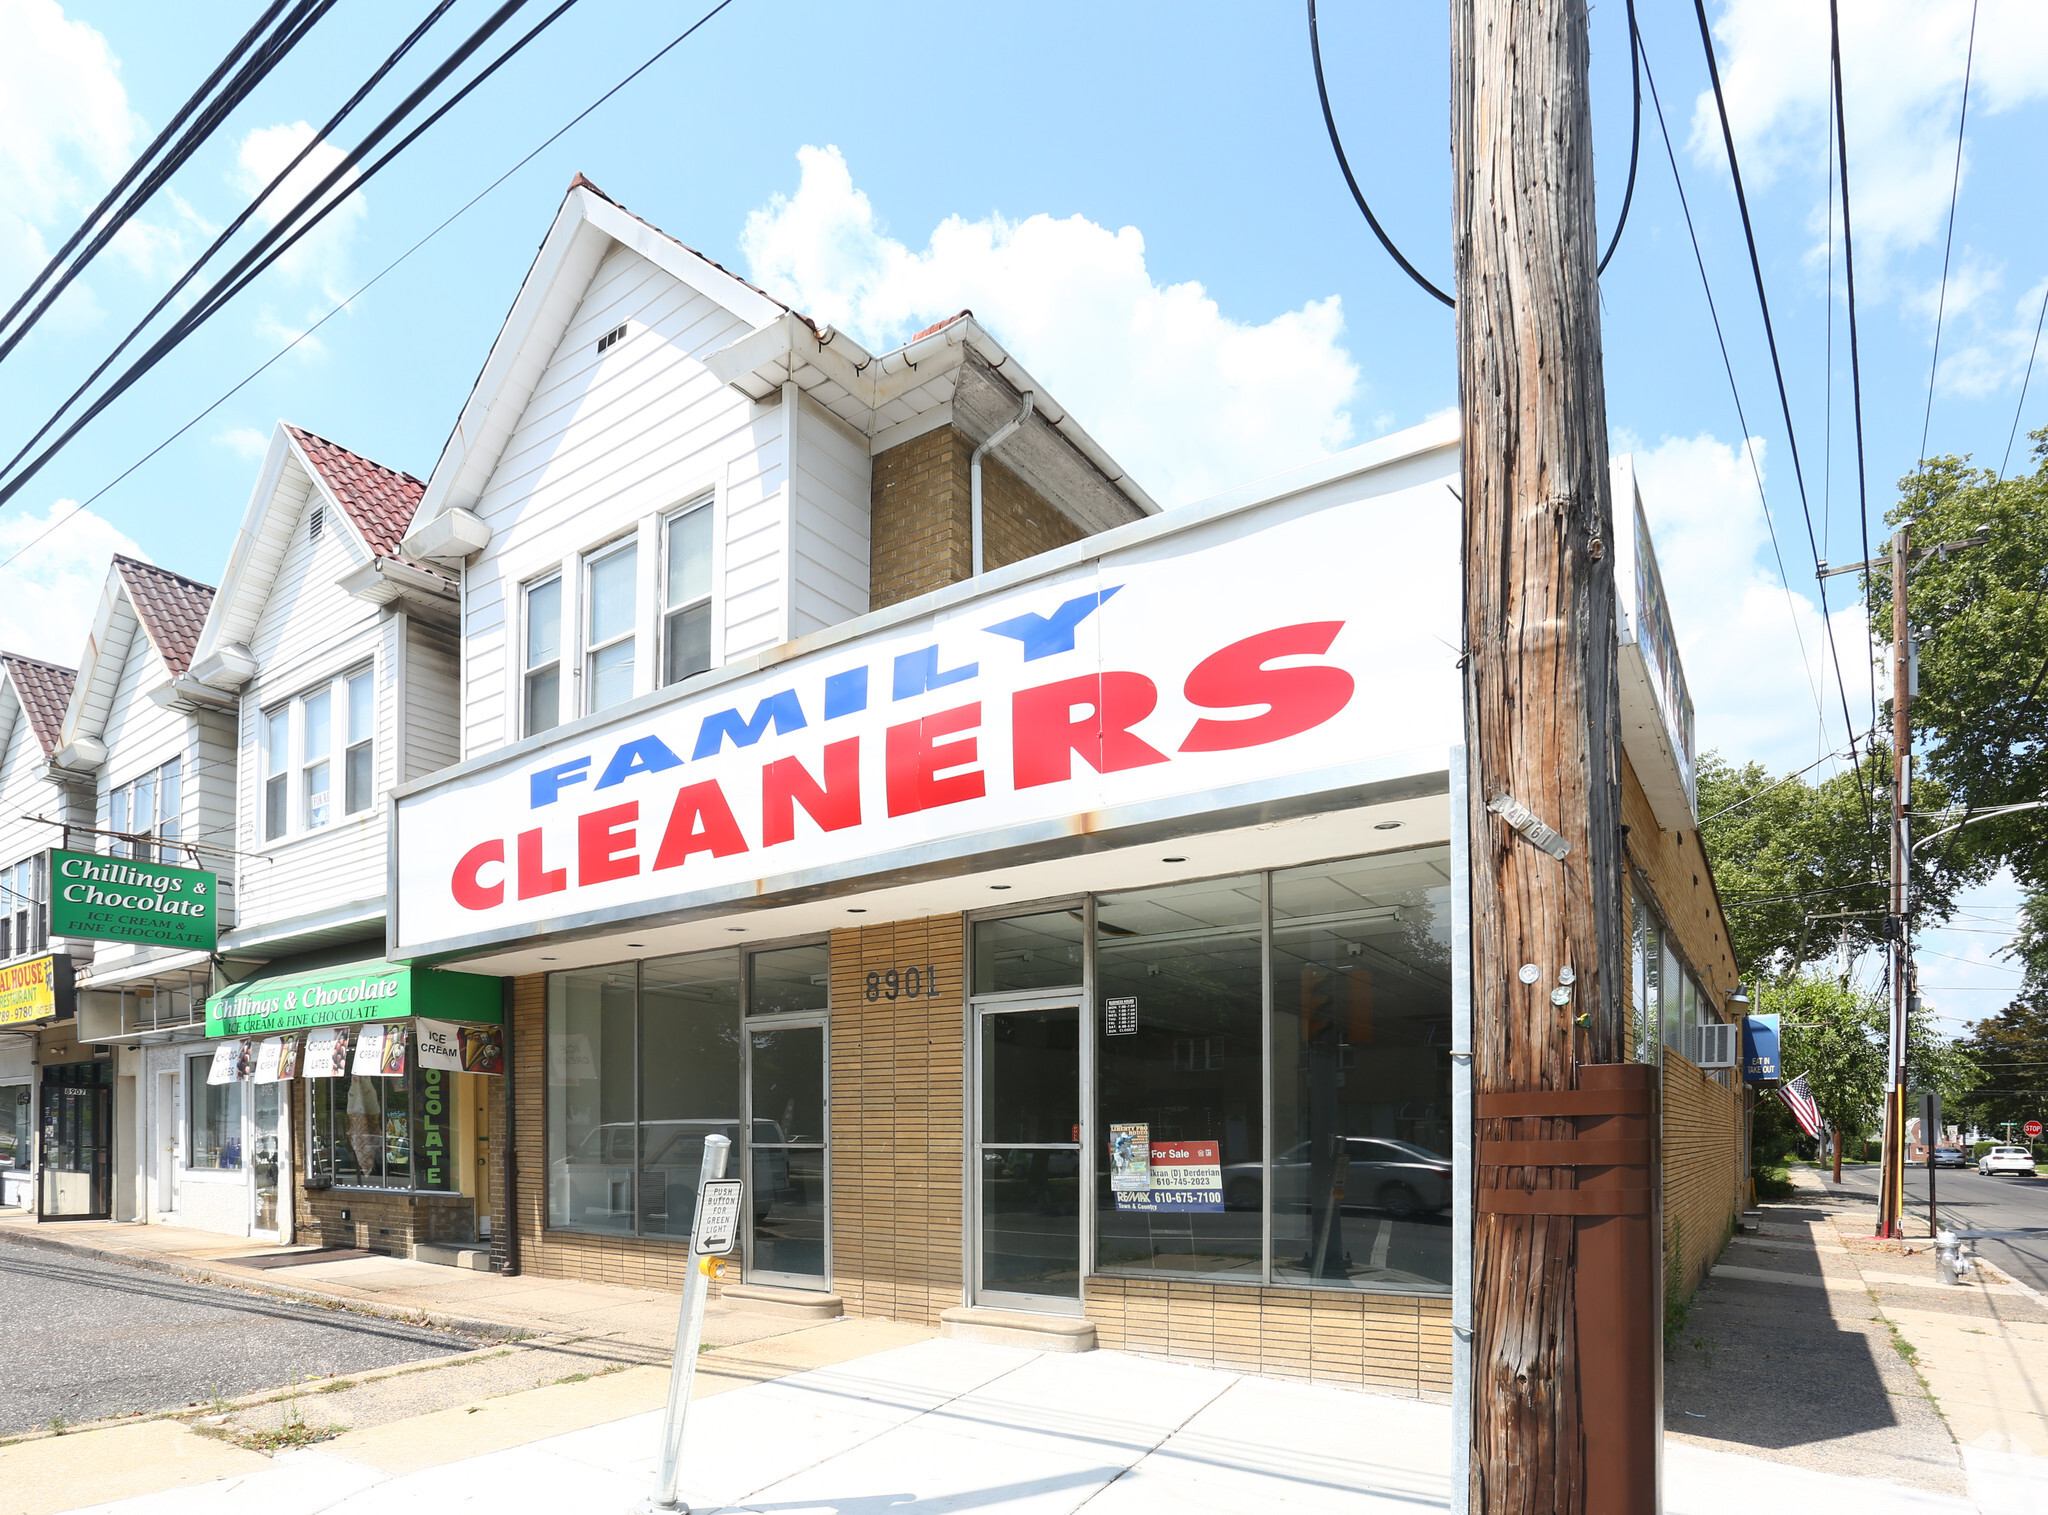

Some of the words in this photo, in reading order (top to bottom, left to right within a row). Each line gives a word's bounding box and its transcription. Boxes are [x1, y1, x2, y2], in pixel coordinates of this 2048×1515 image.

[531, 584, 1122, 808] FAMILY
[452, 621, 1355, 911] CLEANERS
[1507, 807, 1552, 846] 40761
[61, 859, 184, 893] Chillings
[193, 882, 208, 895] &
[63, 884, 206, 917] Chocolate
[87, 911, 115, 923] ICE
[118, 915, 171, 929] CREAM
[175, 922, 187, 930] &
[68, 921, 106, 933] FINE
[109, 926, 204, 943] CHOCOLATE
[11, 963, 43, 989] HOUSE
[866, 965, 941, 1003] 8901
[213, 997, 280, 1020] Chillings
[284, 991, 297, 1011] &
[302, 979, 399, 1009] Chocolate
[228, 1021, 242, 1033] ICE
[243, 1018, 275, 1032] CREAM
[277, 1016, 284, 1028] &
[286, 1013, 309, 1027] FINE
[311, 1005, 379, 1024] CHOCOLATE
[366, 1036, 378, 1046] ICE
[428, 1031, 447, 1045] ICE
[360, 1050, 380, 1059] CREAM
[420, 1043, 458, 1058] CREAM
[311, 1058, 329, 1069] LATES
[1752, 1057, 1763, 1065] EAT
[1763, 1057, 1771, 1065] IN
[1747, 1066, 1761, 1074] TAKE
[1762, 1065, 1775, 1073] OUT
[65, 1088, 86, 1096] 8907
[1151, 1150, 1167, 1159] For
[1168, 1149, 1190, 1159] Sale
[1171, 1169, 1182, 1178] (D)
[1183, 1168, 1220, 1177] Derderian
[1156, 1177, 1210, 1186] 610-745-2023
[713, 1188, 733, 1196] PUSH
[1117, 1191, 1151, 1203] RE/MAX
[1154, 1191, 1221, 1203] 610-675-7100
[707, 1197, 736, 1205] BUTTON
[1137, 1203, 1157, 1211] Country
[706, 1216, 730, 1224] GREEN
[706, 1225, 727, 1233] LIGHT
